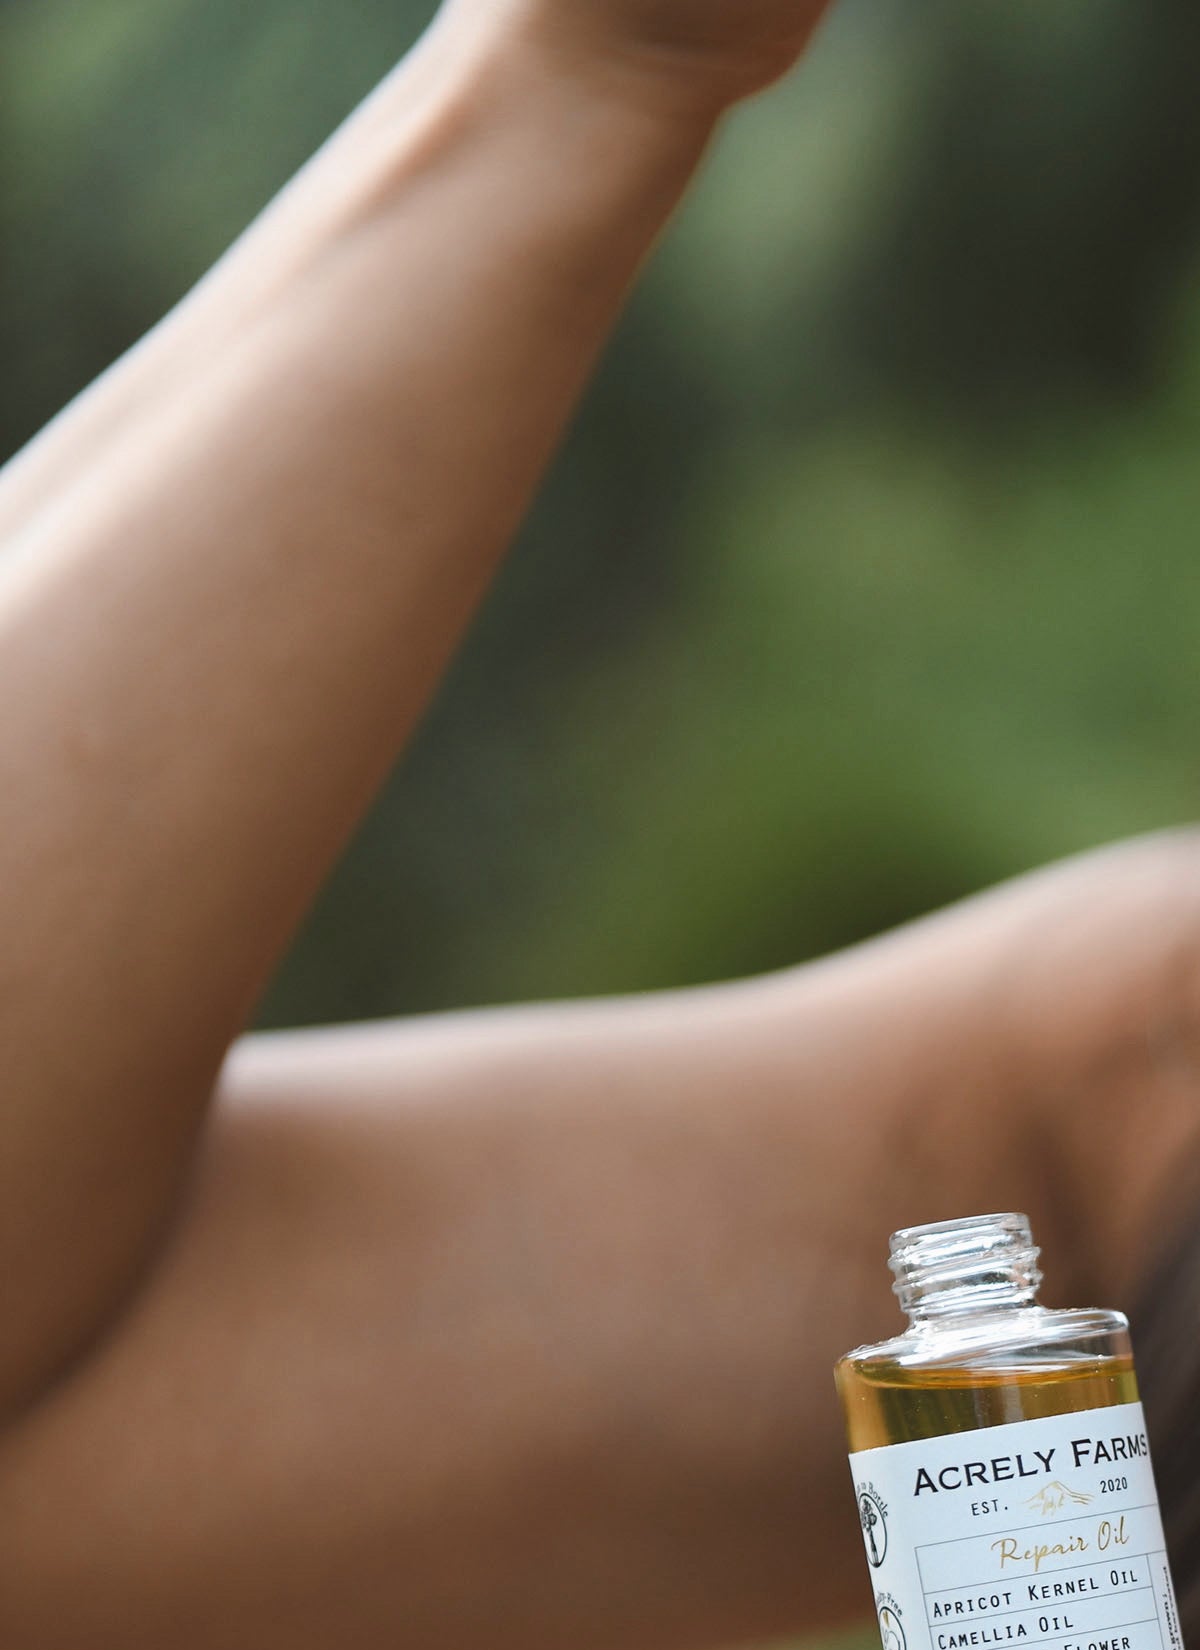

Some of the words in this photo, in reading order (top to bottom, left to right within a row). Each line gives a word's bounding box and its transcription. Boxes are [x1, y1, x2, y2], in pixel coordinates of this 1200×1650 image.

[913, 1449, 1056, 1496] ACRELY
[1070, 1433, 1148, 1467] FARMS
[971, 1499, 1008, 1516] EST.
[1100, 1477, 1128, 1494] 2020
[991, 1536, 1088, 1572] Repair
[1098, 1516, 1129, 1551] Oil
[933, 1592, 1012, 1618] APRICOT
[1028, 1578, 1099, 1600] KERNEL
[1110, 1570, 1138, 1586] OIL
[937, 1623, 1027, 1650] CAMELLIA
[1039, 1616, 1074, 1632] OIL
